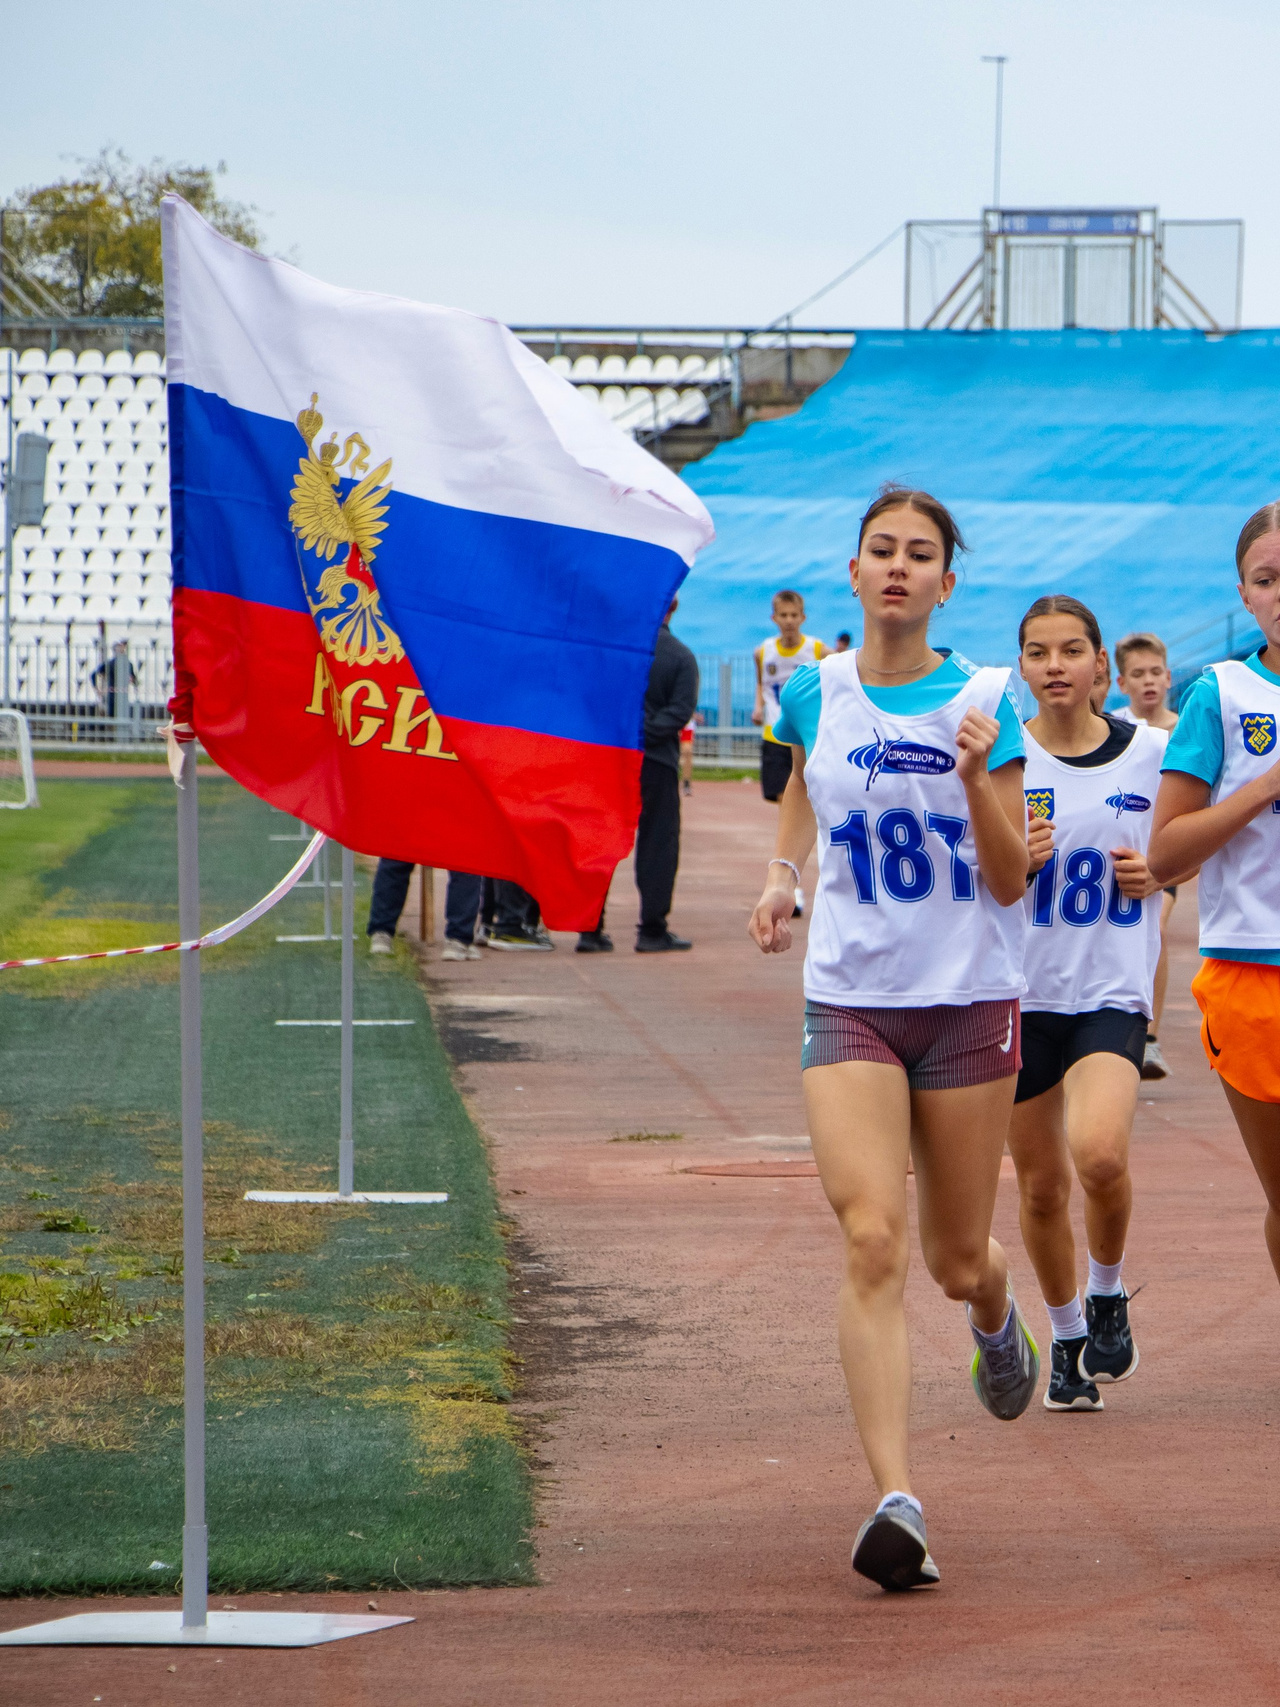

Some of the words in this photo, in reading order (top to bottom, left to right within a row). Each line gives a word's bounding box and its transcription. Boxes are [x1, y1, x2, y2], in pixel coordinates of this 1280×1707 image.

[888, 750, 934, 763] СДЮСШОР
[947, 758, 953, 767] 3
[830, 808, 975, 904] 187
